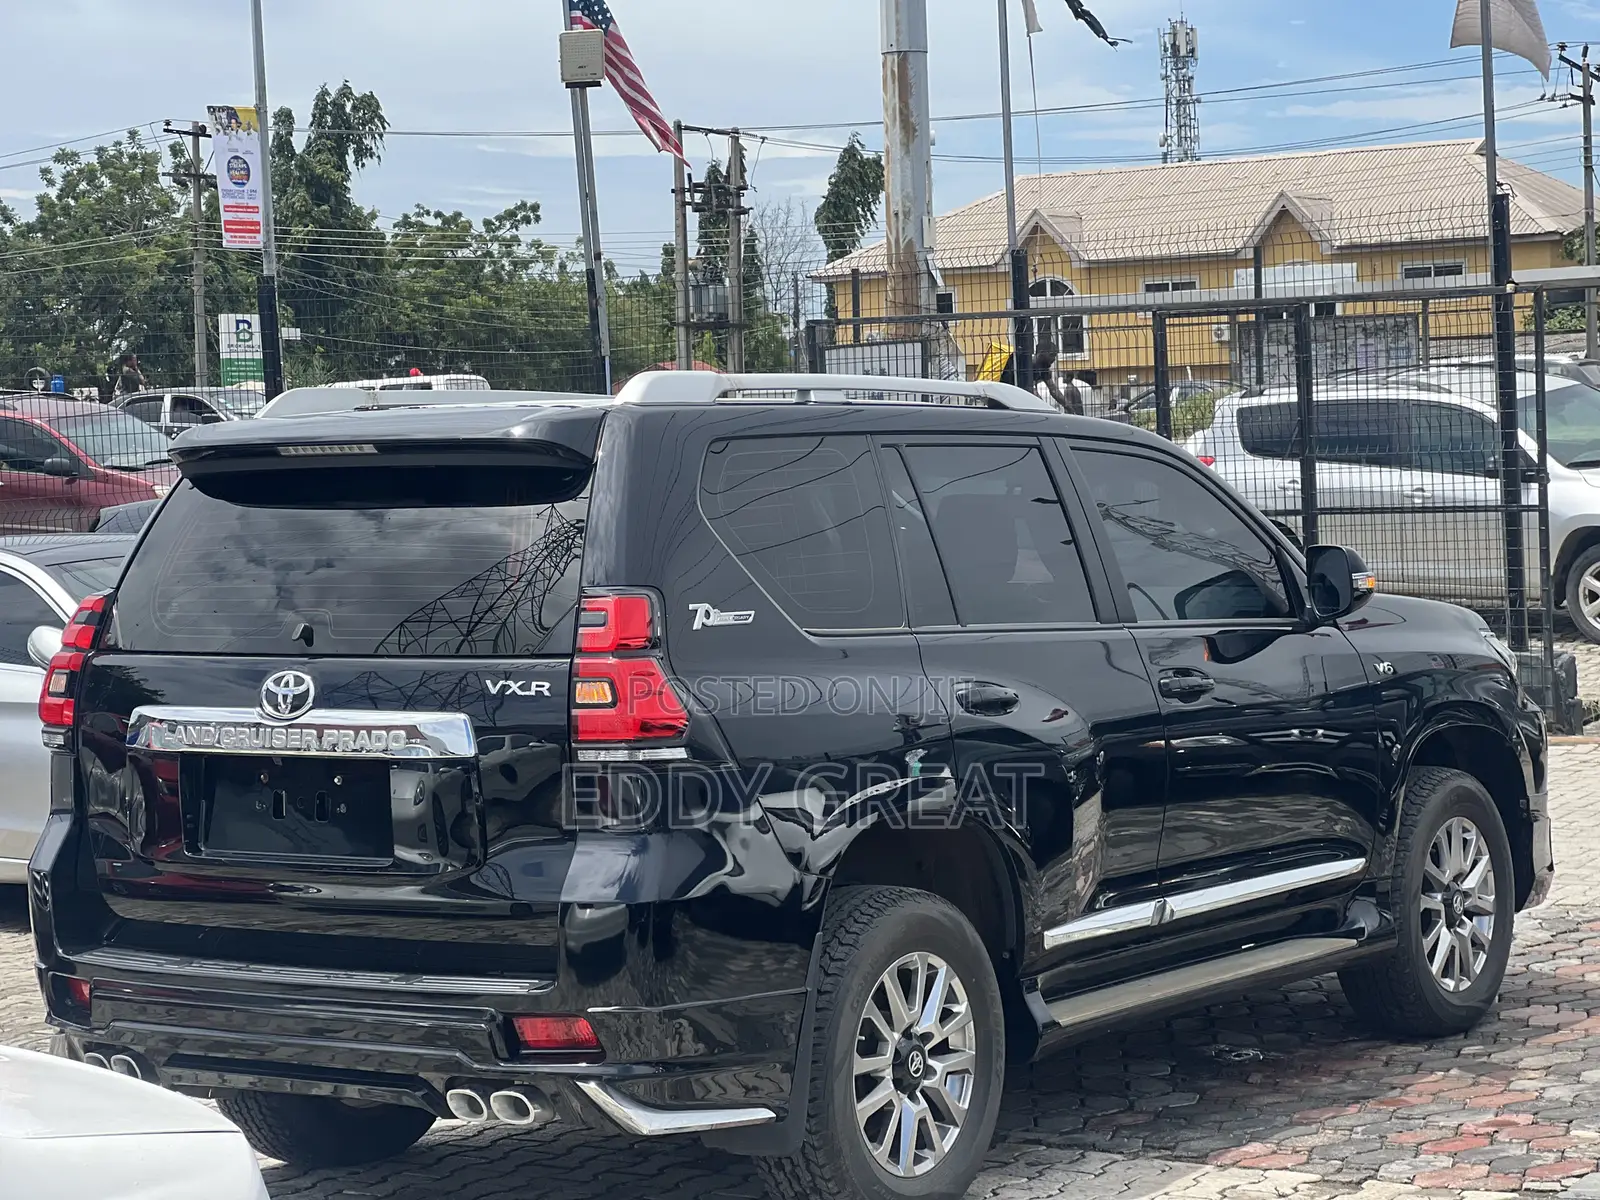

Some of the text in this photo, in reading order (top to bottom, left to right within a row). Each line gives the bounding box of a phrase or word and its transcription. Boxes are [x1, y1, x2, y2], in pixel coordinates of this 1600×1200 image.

[1373, 661, 1394, 675] V6
[162, 723, 407, 752] LAND CRUISER PRADO
